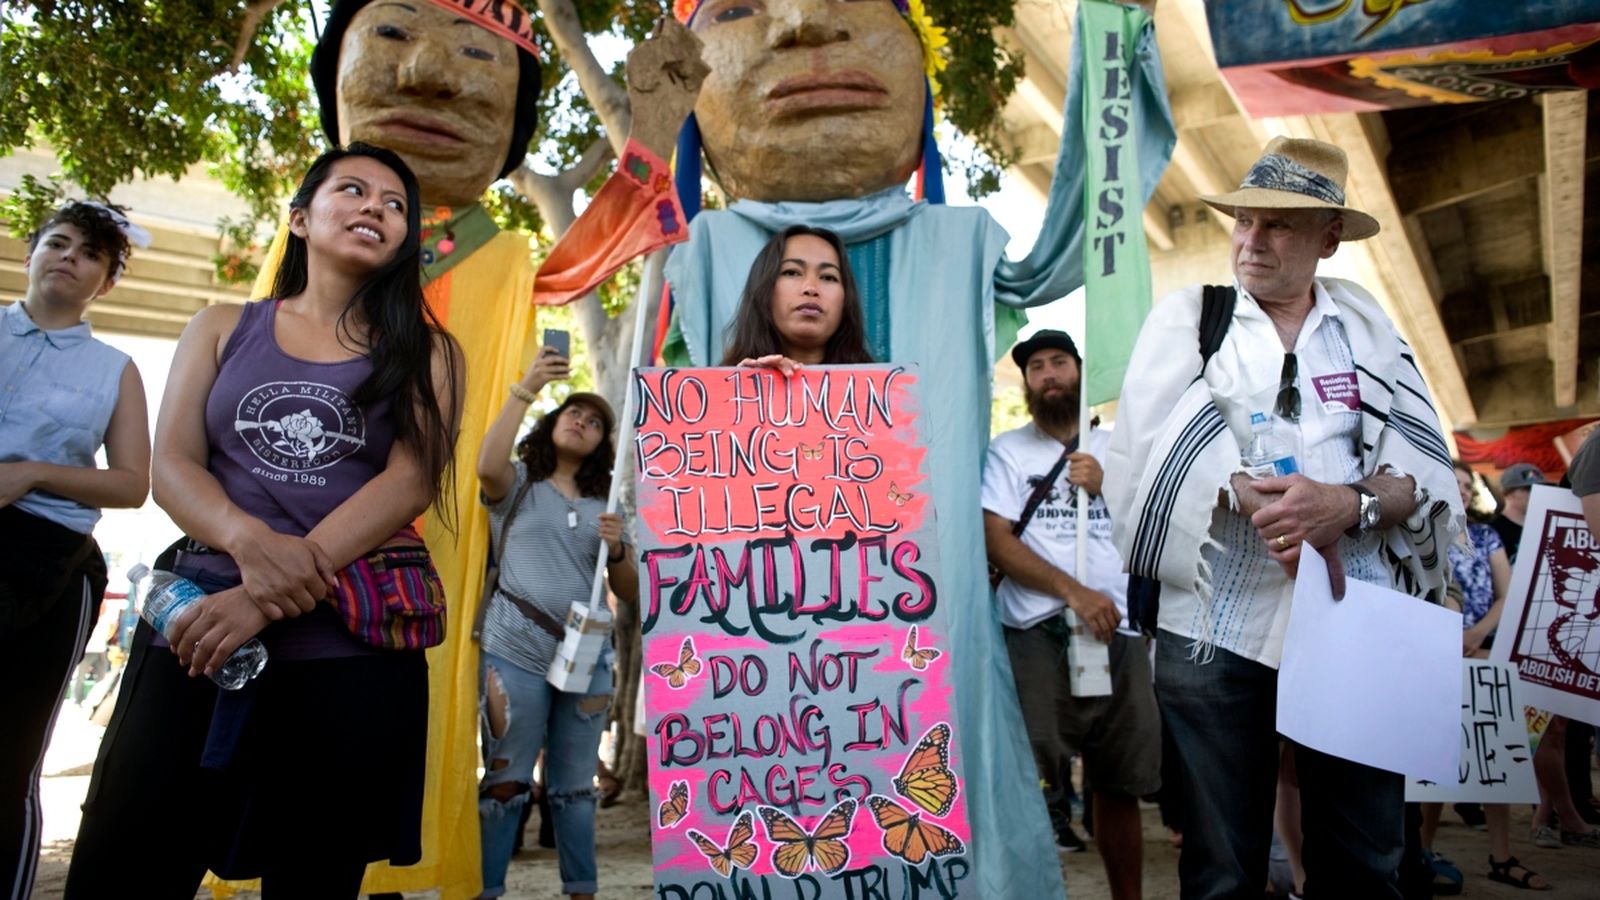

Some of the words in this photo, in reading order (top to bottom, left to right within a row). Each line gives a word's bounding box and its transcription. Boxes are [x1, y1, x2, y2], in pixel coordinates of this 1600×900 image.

[246, 386, 290, 415] HELLA
[300, 386, 357, 434] MILITANT
[633, 369, 708, 427] NO
[725, 367, 905, 436] HUMAN
[252, 467, 288, 482] since
[294, 473, 327, 486] 1989
[635, 426, 799, 482] BEING
[824, 433, 884, 483] IS
[658, 482, 903, 536] ILLEGAL
[641, 531, 937, 644] FAMILIES
[709, 654, 768, 699] DO
[788, 639, 880, 694] NOT
[1462, 665, 1515, 722] ISH
[1520, 659, 1575, 686] ABOLISH
[655, 694, 831, 772] BELONG
[843, 678, 922, 752] IN
[707, 763, 872, 815] CAGES
[831, 856, 969, 900] TRUMP
